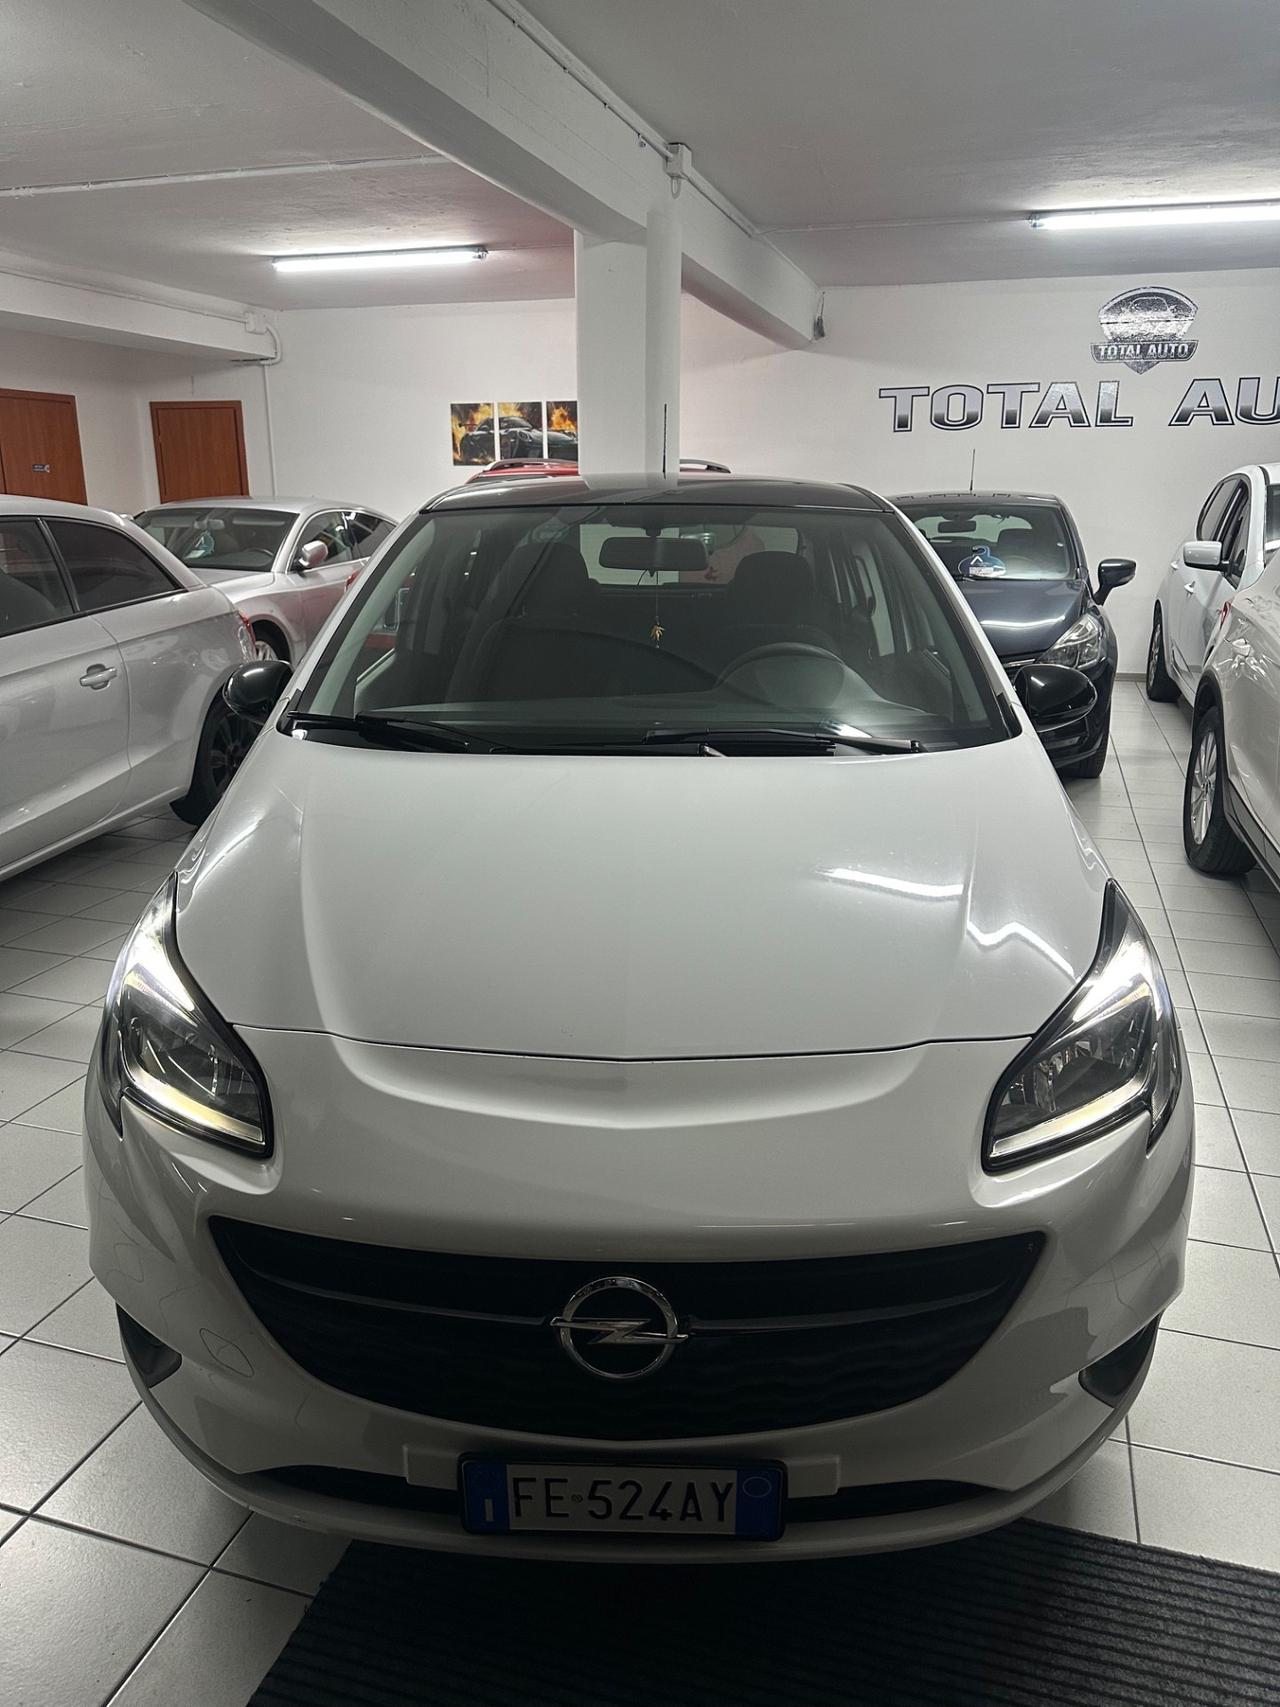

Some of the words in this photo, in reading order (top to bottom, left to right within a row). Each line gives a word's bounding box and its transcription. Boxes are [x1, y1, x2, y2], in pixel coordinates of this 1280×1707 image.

[1098, 344, 1142, 360] TOTAL
[1146, 343, 1189, 359] AUTO
[878, 380, 1134, 433] TOTAL
